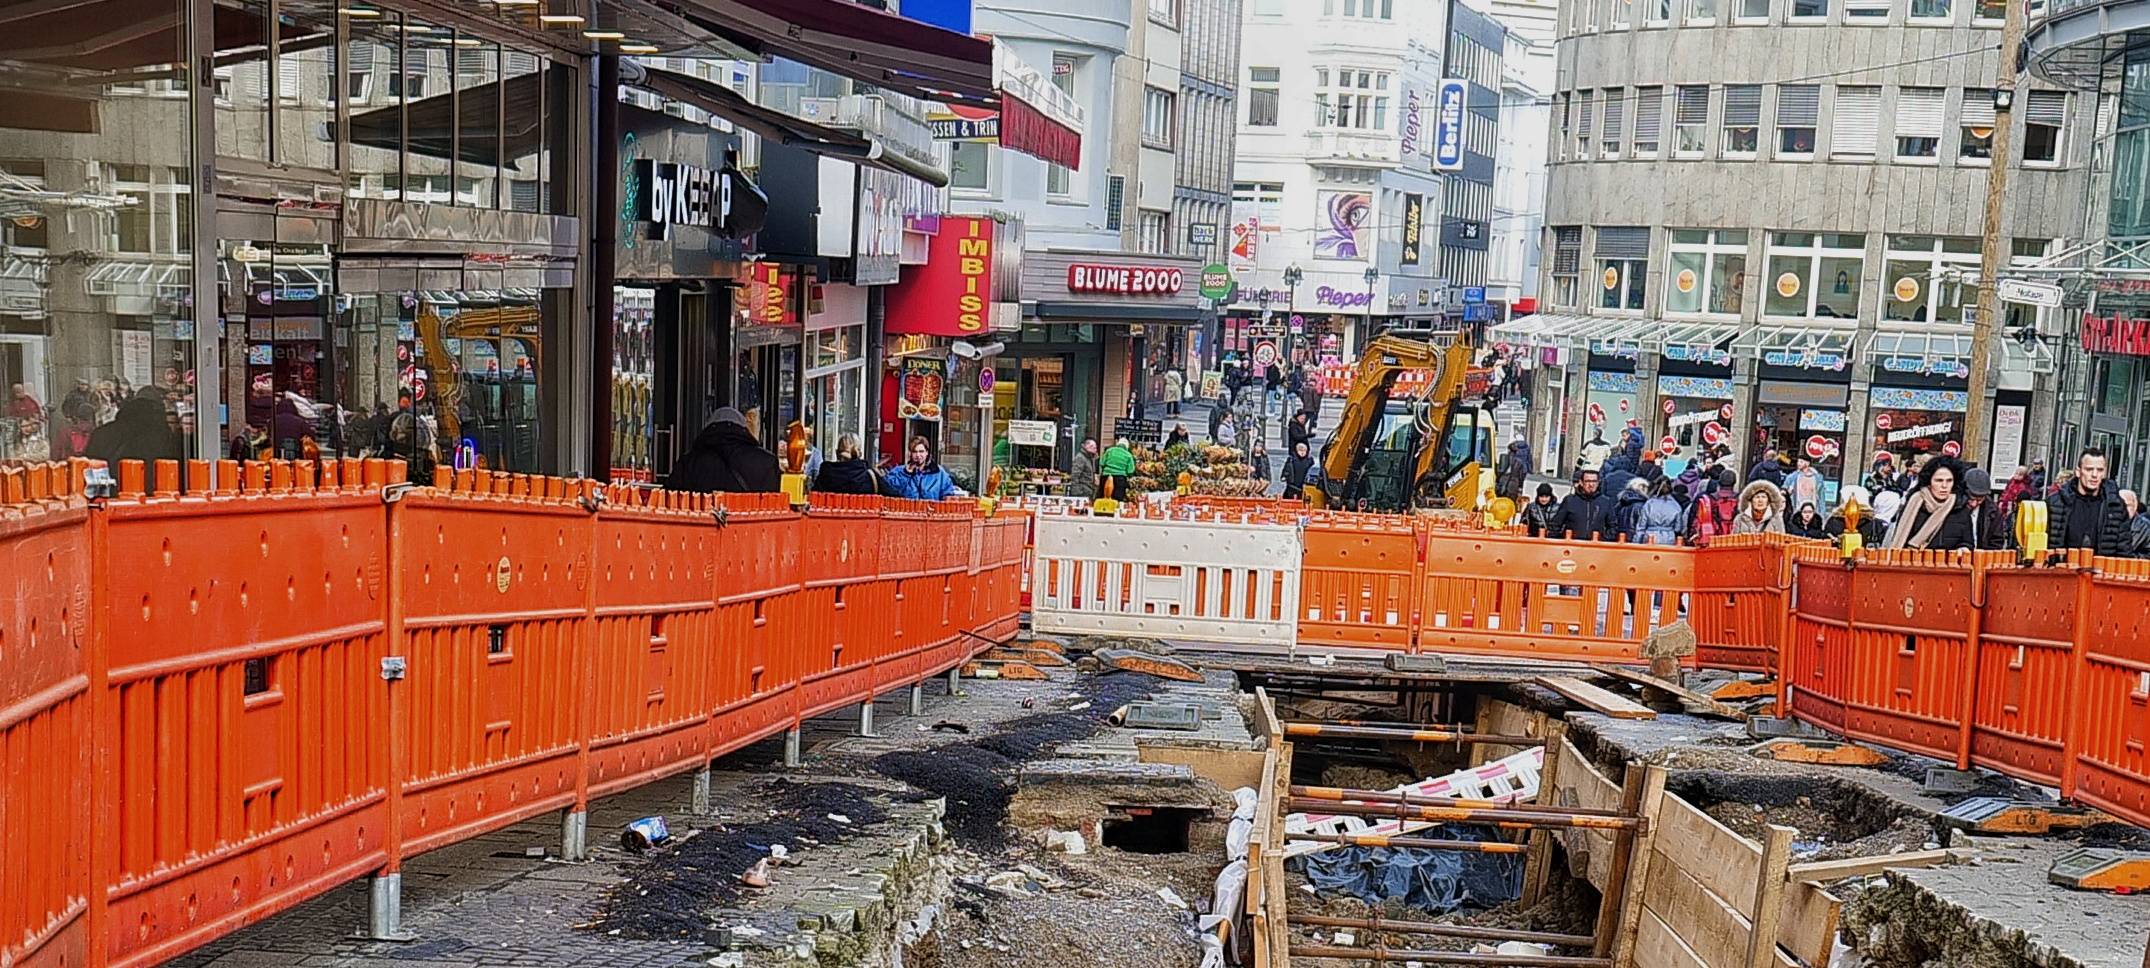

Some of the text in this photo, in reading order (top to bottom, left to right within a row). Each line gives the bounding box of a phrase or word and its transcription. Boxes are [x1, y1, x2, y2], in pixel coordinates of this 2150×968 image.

[928, 119, 957, 137] SSEN
[960, 121, 970, 137] &
[1401, 89, 1421, 154] Pieper
[1440, 90, 1460, 157] Berlitz
[958, 219, 988, 332] IMBISS
[1074, 266, 1182, 293] BLUME 2000
[1315, 285, 1376, 309] Pieper
